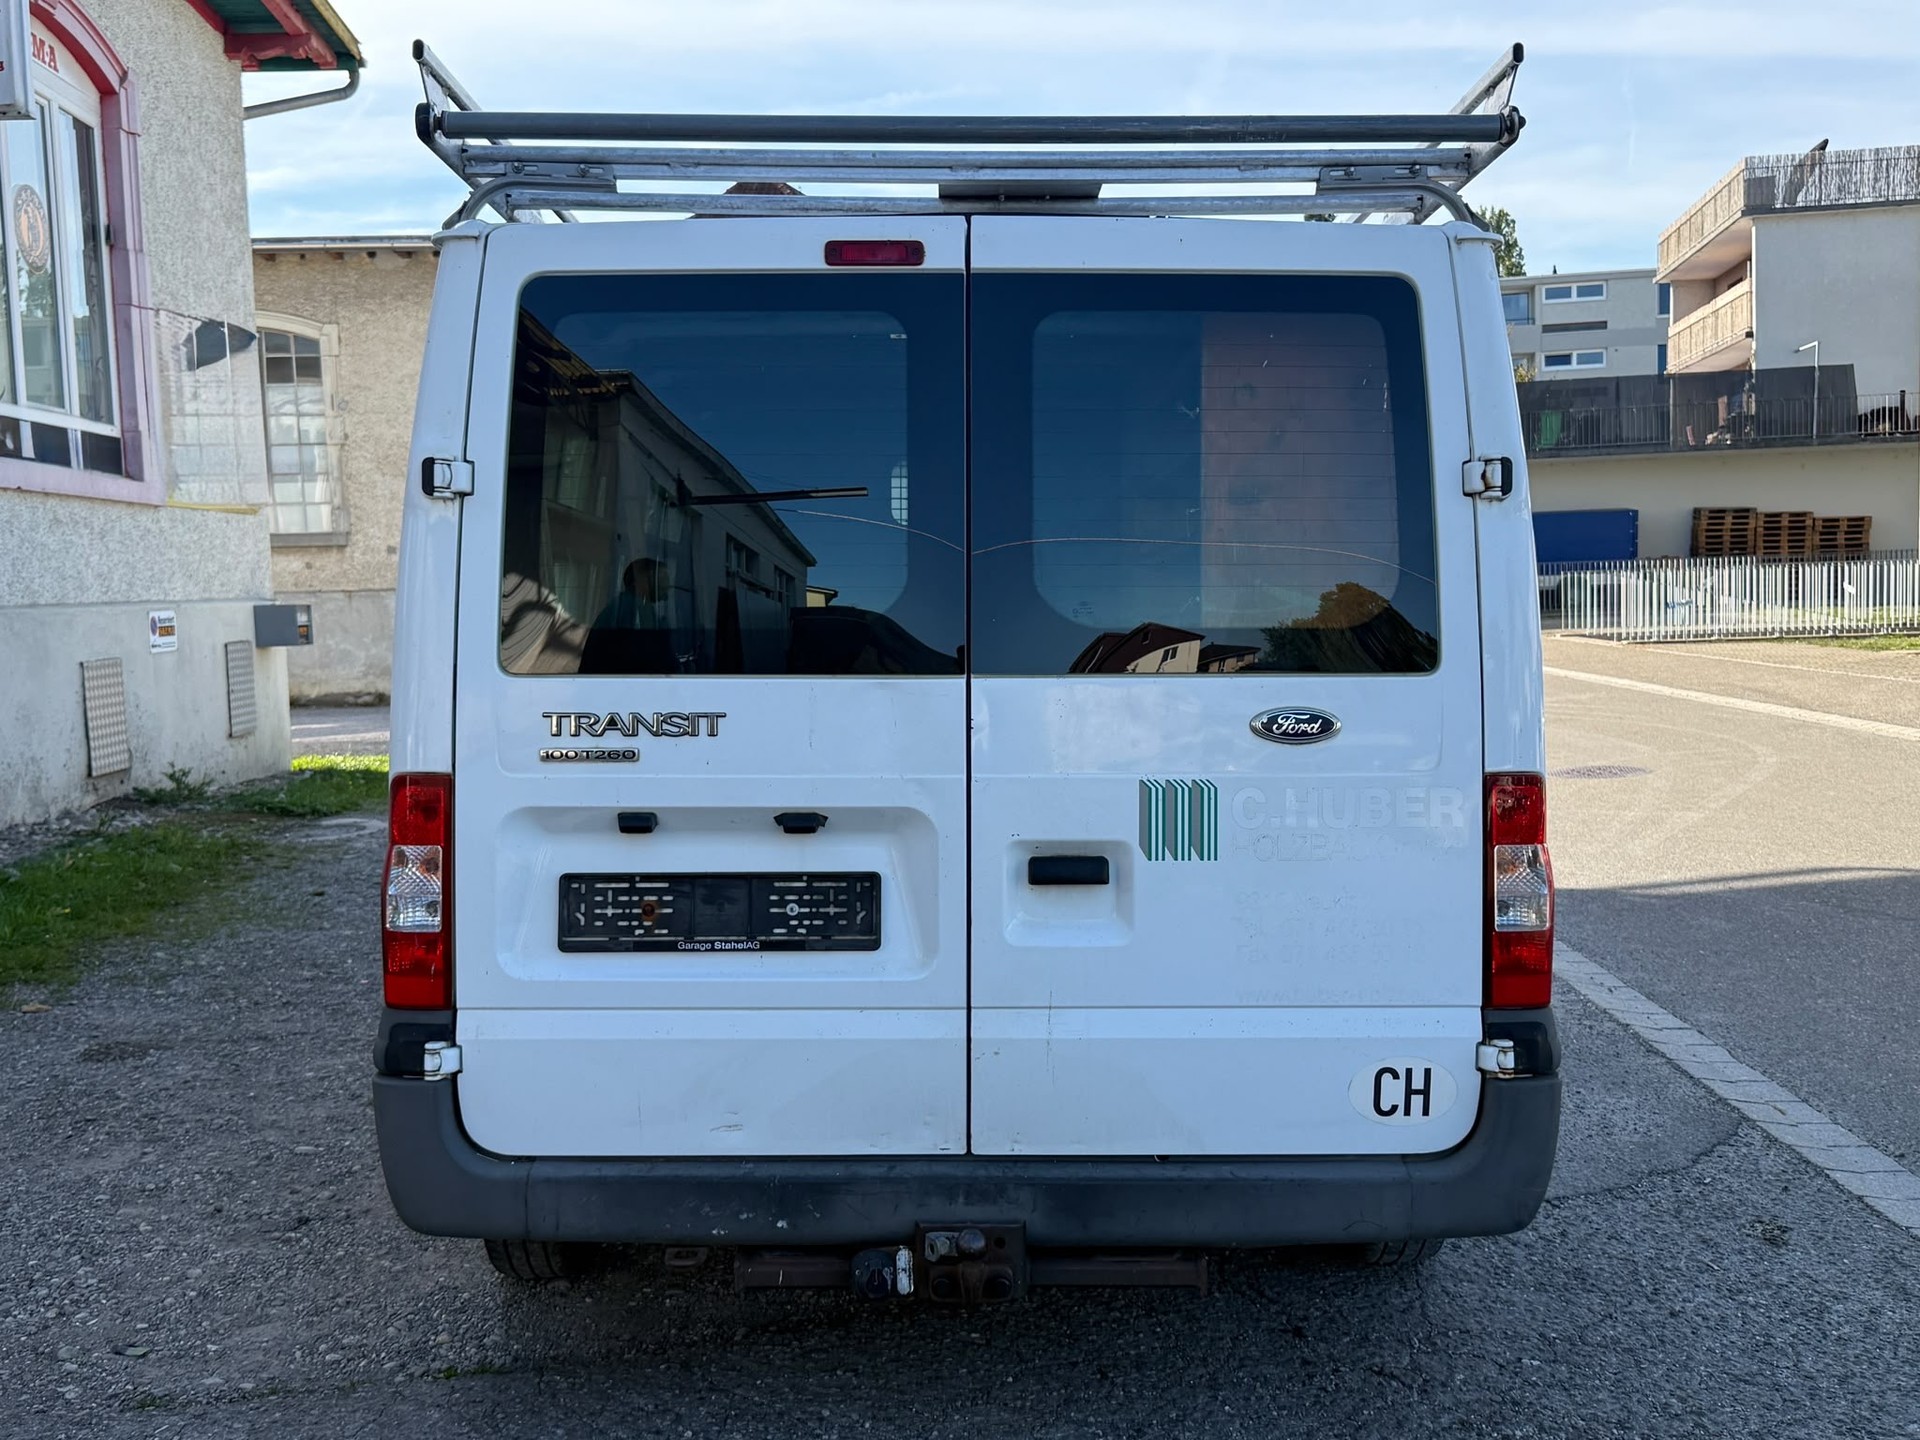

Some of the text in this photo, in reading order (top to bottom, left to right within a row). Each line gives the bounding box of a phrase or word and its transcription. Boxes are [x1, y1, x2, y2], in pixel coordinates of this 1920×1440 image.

[542, 711, 727, 737] TRANSIT
[1272, 713, 1323, 735] Ford
[540, 748, 637, 760] 100T260
[677, 941, 712, 951] Garage
[1373, 1066, 1432, 1117] CH
